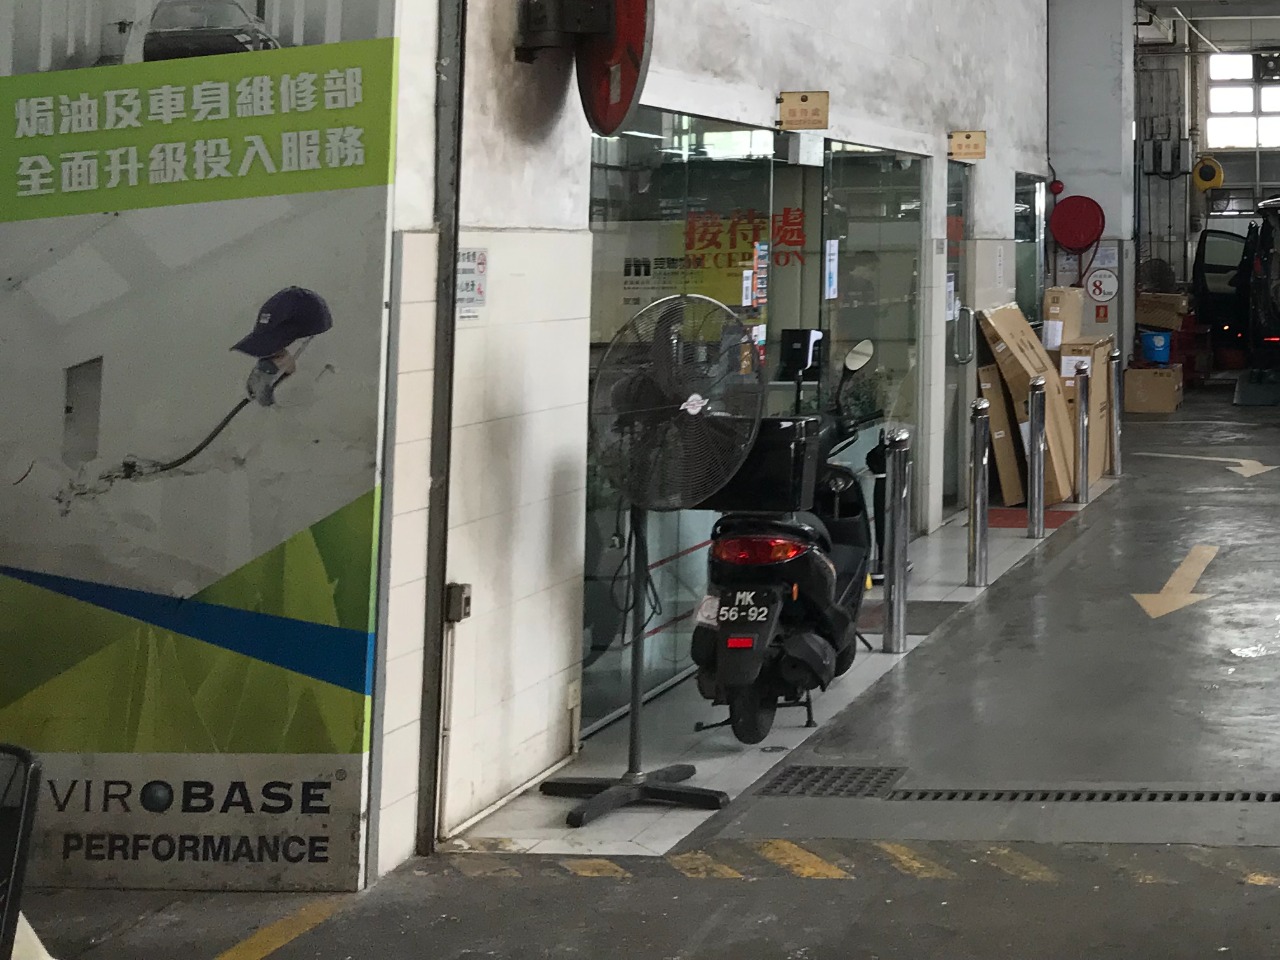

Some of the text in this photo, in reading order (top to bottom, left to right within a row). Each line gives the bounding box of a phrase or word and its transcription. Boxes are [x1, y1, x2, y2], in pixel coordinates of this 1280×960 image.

[15, 67, 364, 139] 焗油及車身維修部
[16, 125, 366, 197] 全面升級投入服務
[685, 250, 806, 270] RECEPON
[1092, 279, 1103, 296] 8
[735, 591, 756, 606] MK
[719, 607, 768, 622] 56-92
[62, 834, 330, 863] PERFORMANCE
